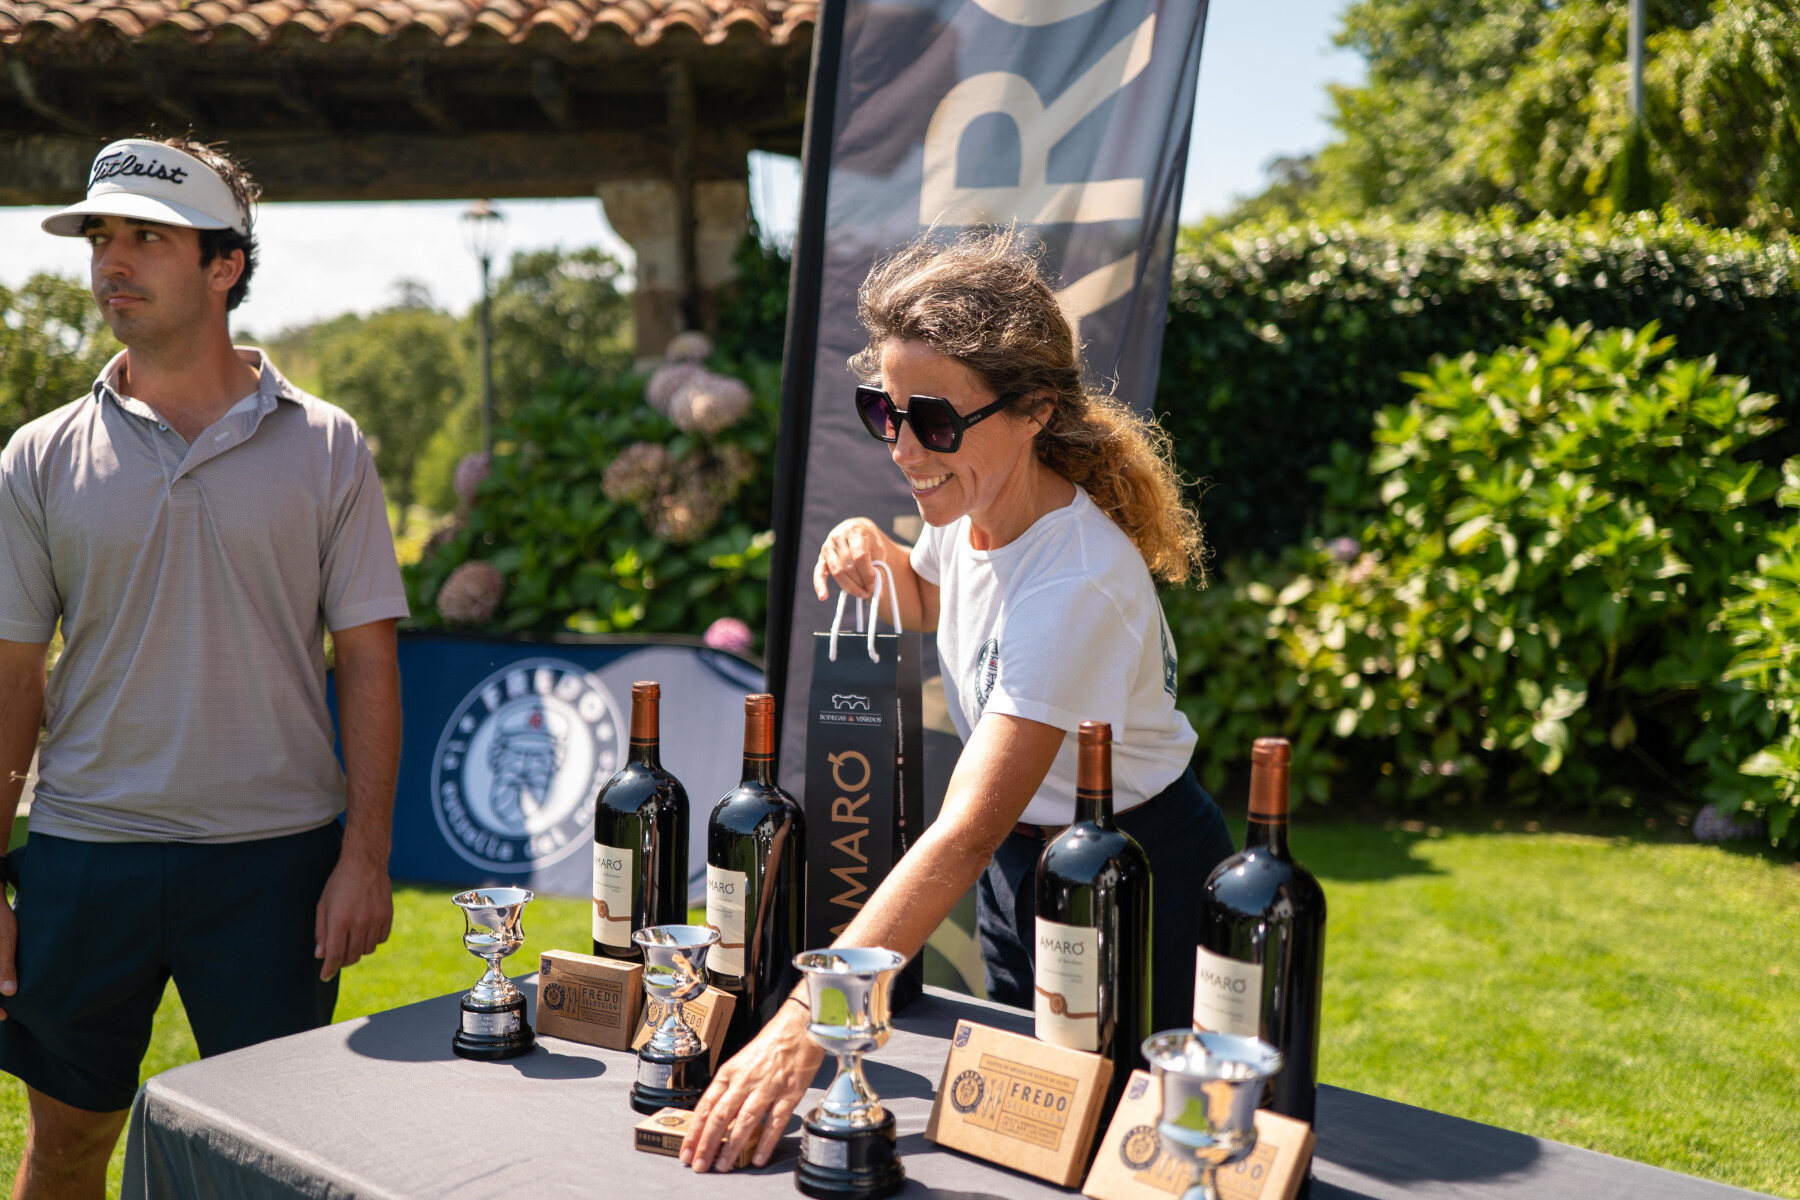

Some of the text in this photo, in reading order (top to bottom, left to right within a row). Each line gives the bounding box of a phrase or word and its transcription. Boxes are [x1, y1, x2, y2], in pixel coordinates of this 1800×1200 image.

[87, 151, 188, 191] Titleist
[480, 665, 607, 724] FREDO
[819, 714, 847, 722] BODEGAS
[855, 716, 882, 724] VIÑEDOS
[581, 998, 618, 1011] SELECCIÓN
[582, 987, 619, 1004] FREDO
[1010, 1082, 1068, 1112] FREDO
